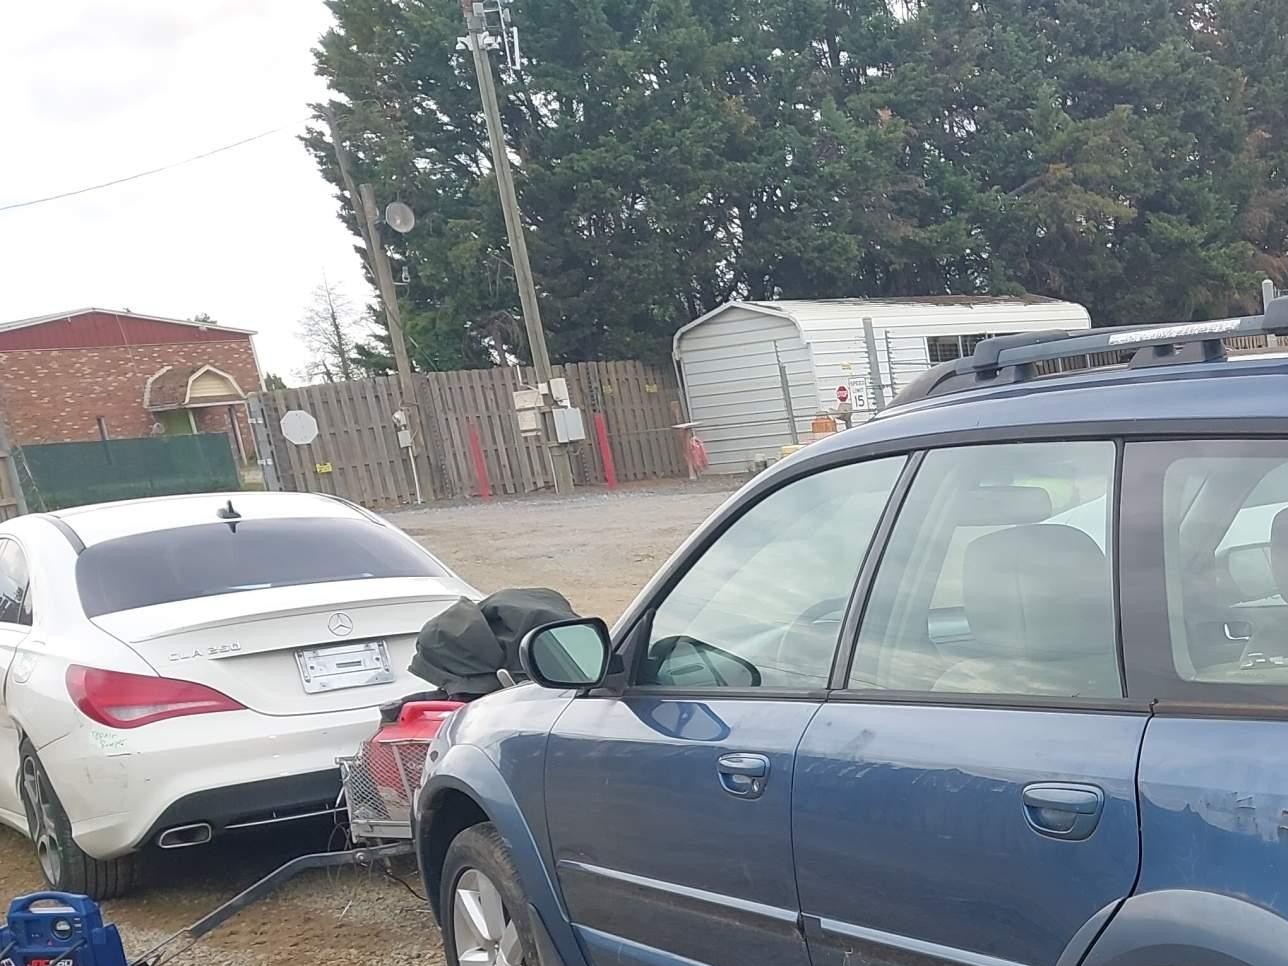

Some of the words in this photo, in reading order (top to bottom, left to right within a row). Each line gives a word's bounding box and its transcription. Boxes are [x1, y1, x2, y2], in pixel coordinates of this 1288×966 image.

[854, 394, 866, 408] 15
[167, 646, 204, 662] CLA
[207, 641, 242, 655] 250
